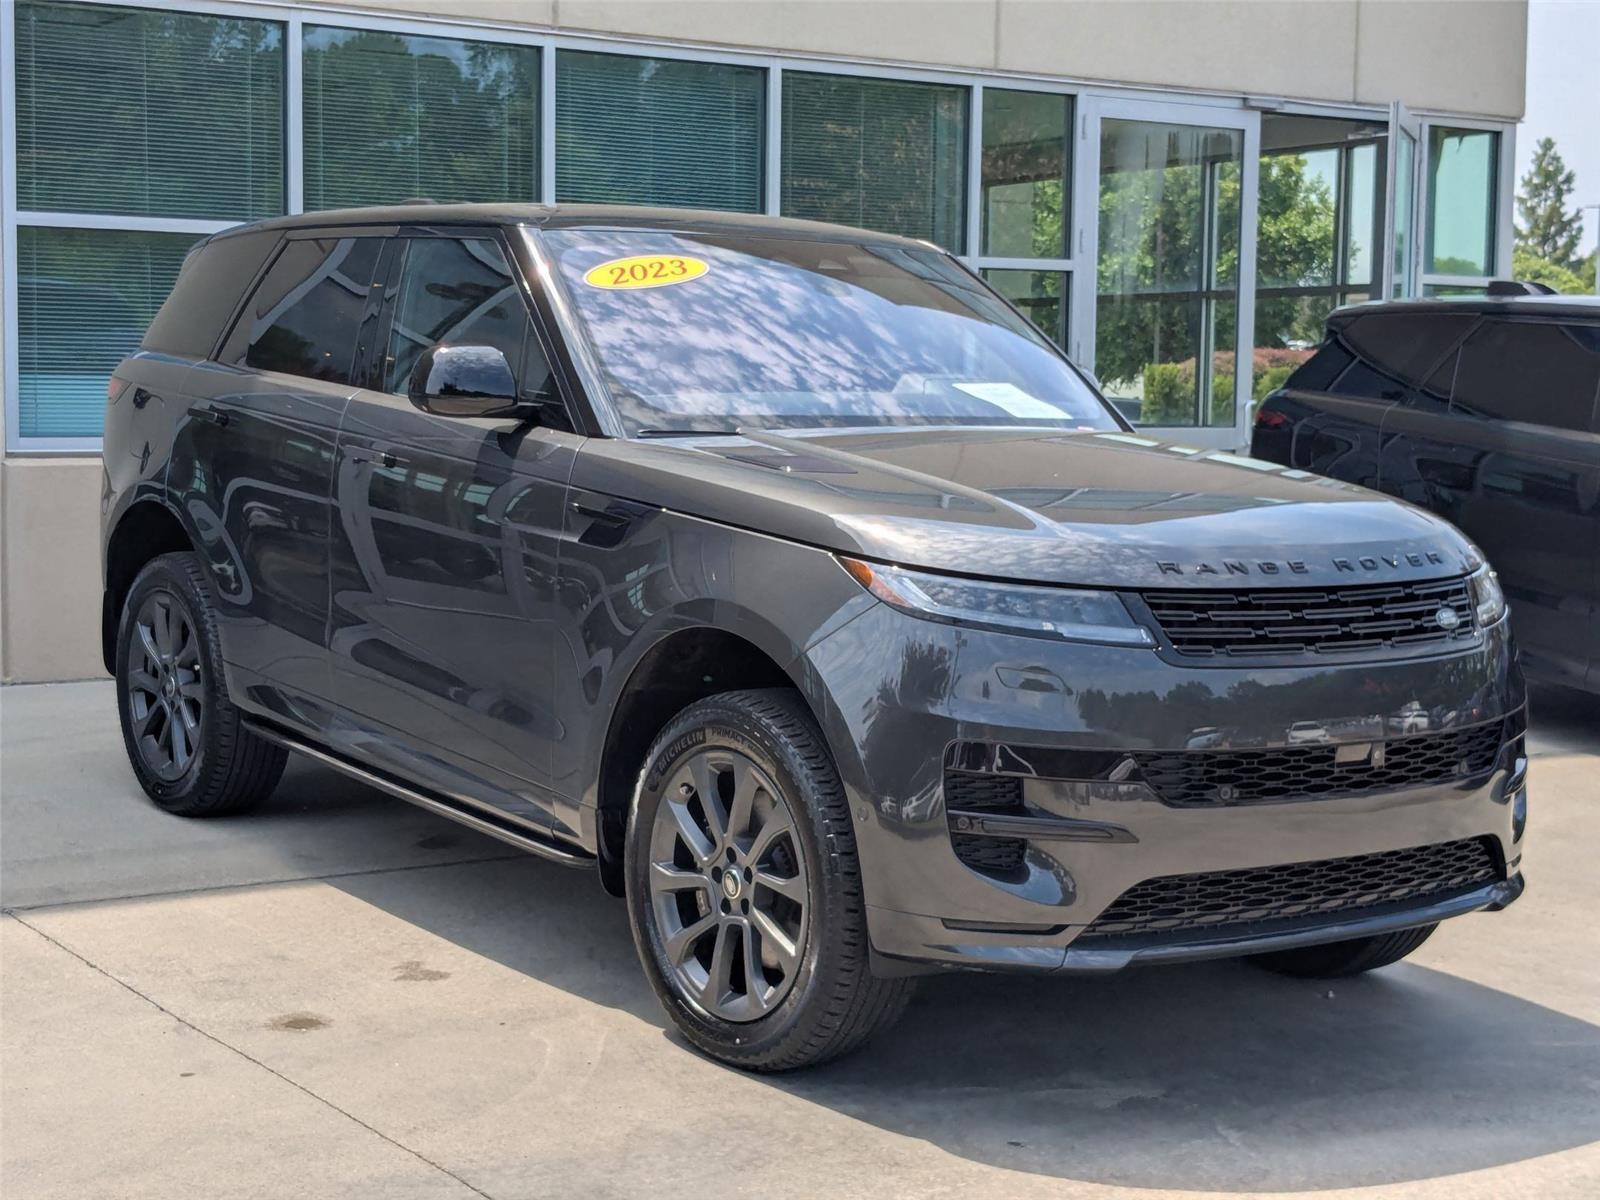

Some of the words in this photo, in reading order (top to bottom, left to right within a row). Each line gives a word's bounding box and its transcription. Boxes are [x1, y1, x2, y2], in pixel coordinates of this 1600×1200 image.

[608, 259, 688, 286] 2023
[1155, 560, 1310, 576] RANGE
[1331, 551, 1443, 573] ROVER
[657, 730, 705, 772] MICHELIN
